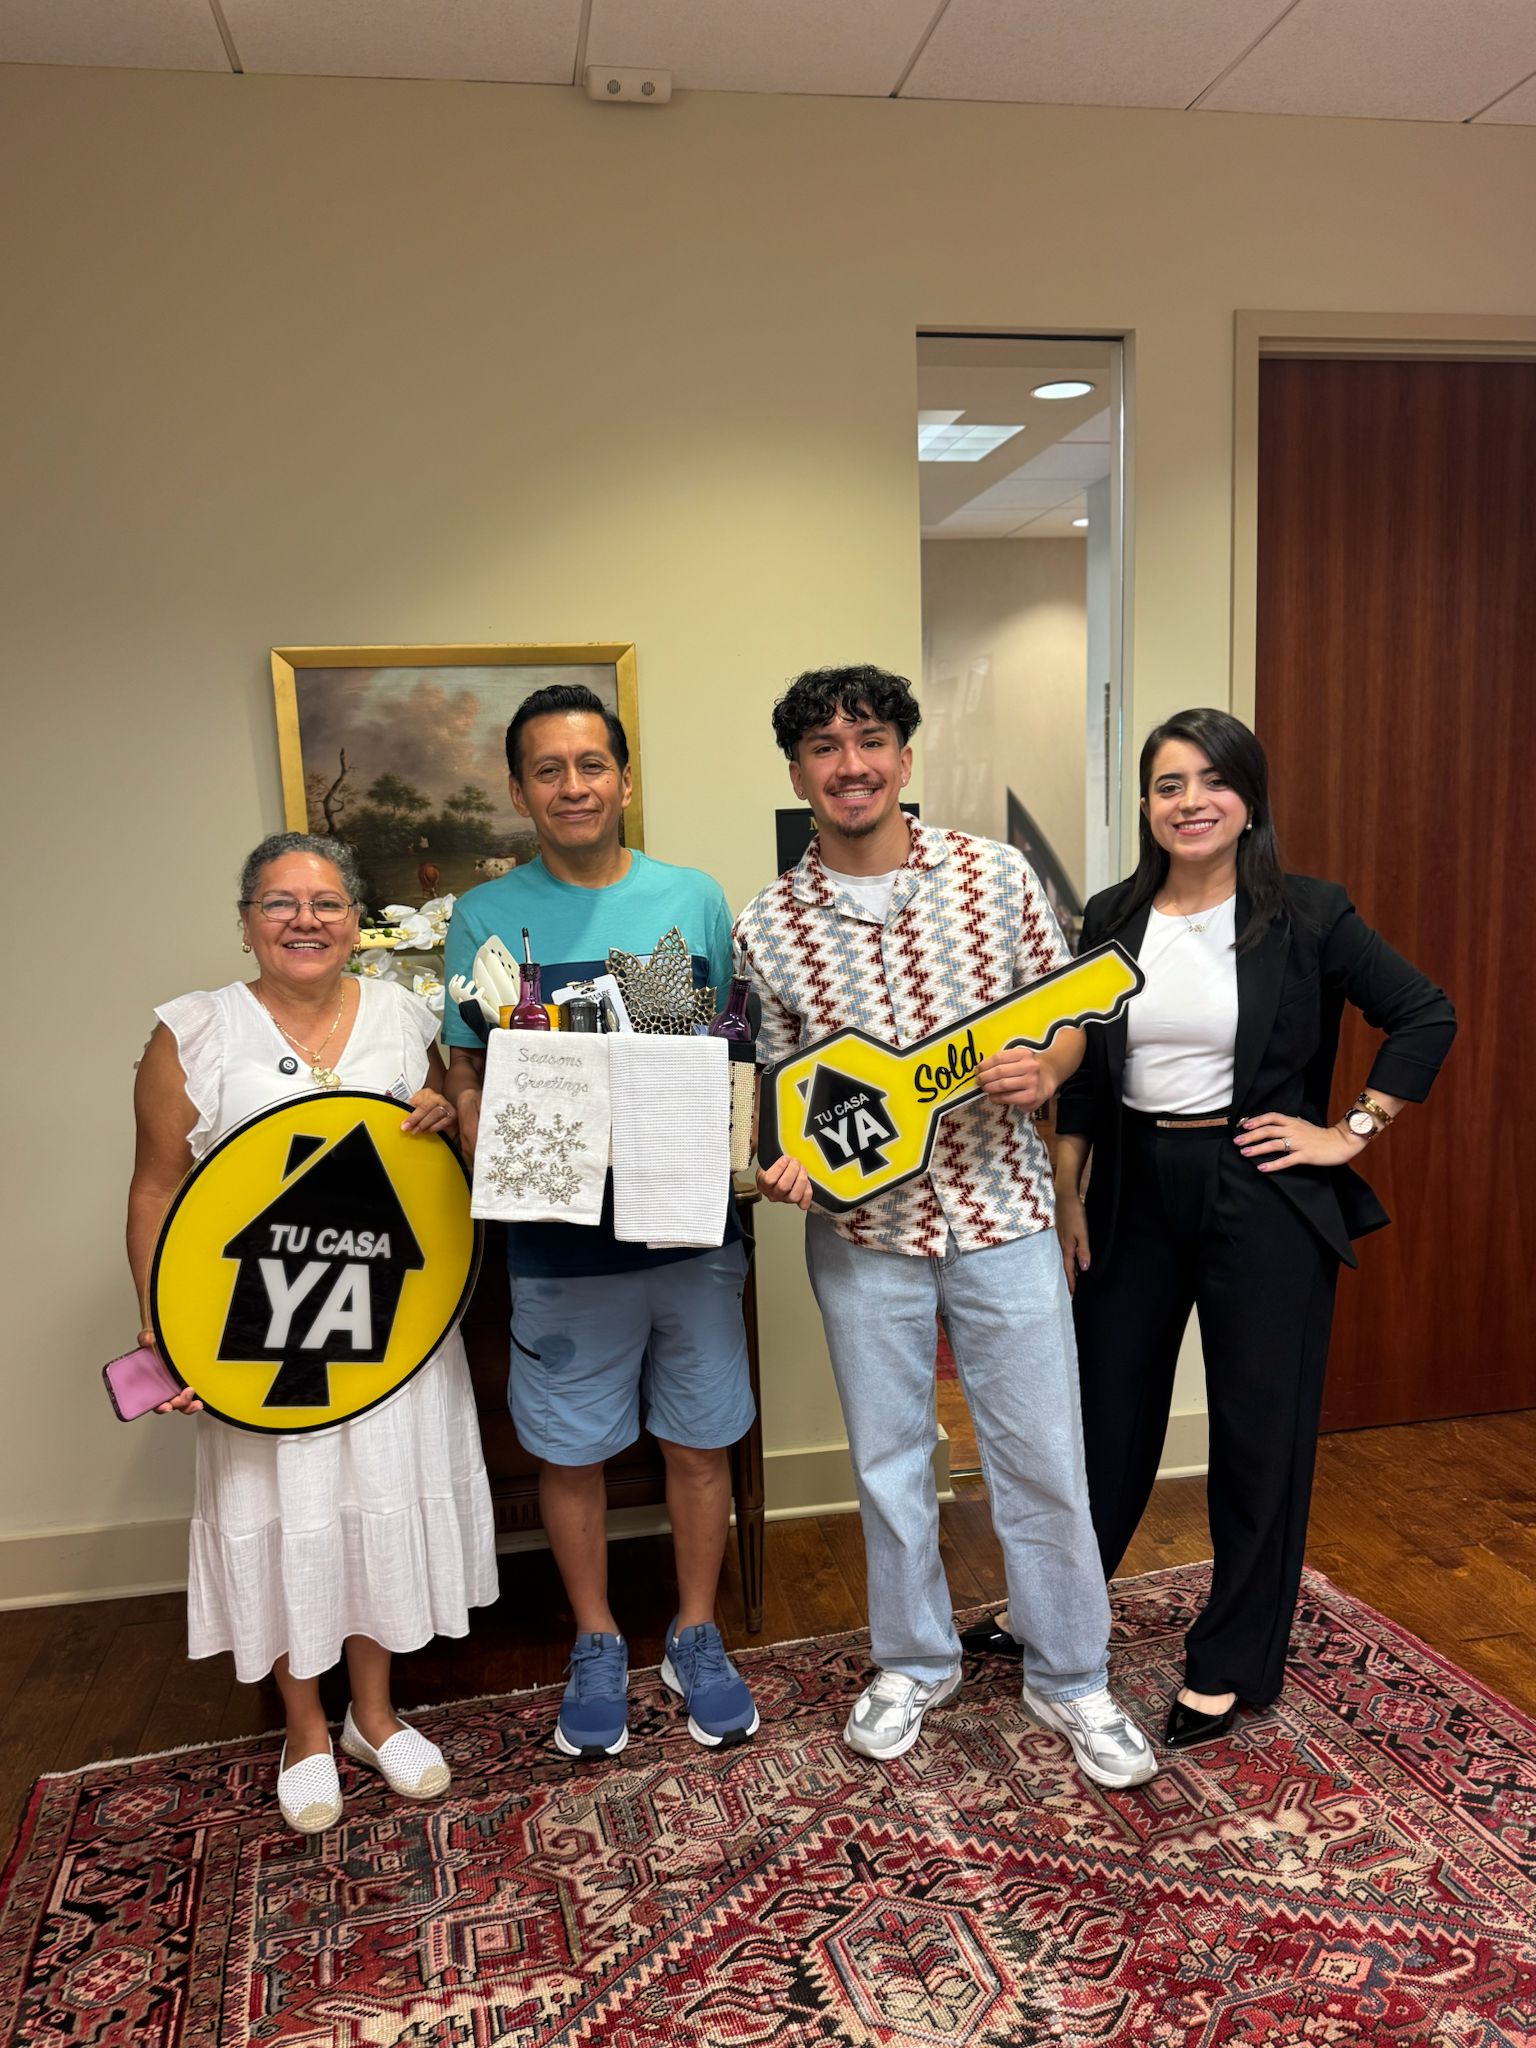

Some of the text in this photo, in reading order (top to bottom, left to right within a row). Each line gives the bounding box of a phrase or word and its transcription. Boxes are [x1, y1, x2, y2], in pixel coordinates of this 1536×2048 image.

[518, 1047, 583, 1067] Seasons
[914, 1028, 983, 1103] Sold
[514, 1072, 589, 1097] Greetings
[814, 1092, 870, 1126] TU CASA
[819, 1108, 891, 1159] YA
[269, 1224, 392, 1259] TU CASA
[258, 1258, 373, 1350] YA
